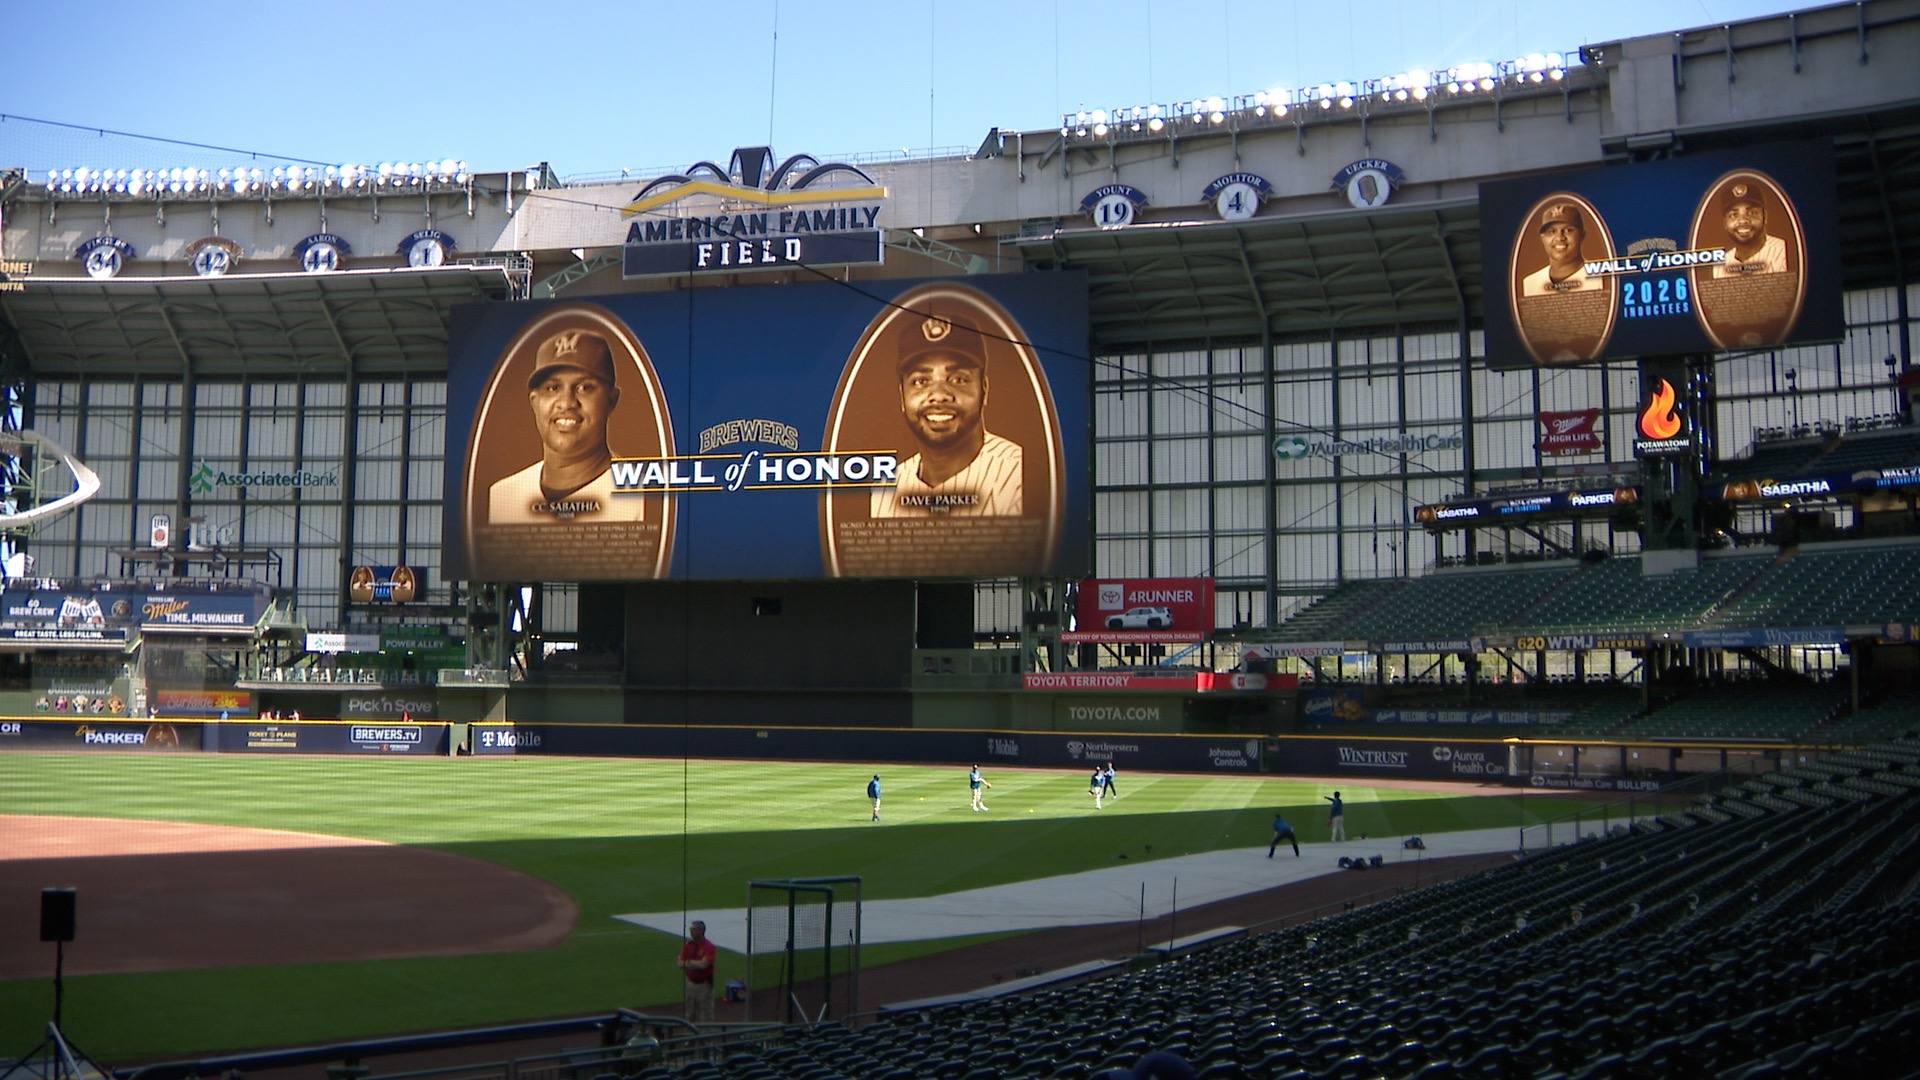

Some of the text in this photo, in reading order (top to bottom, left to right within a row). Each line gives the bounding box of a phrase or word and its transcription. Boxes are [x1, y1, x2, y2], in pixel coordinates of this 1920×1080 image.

[1345, 160, 1389, 175] UECKER
[1212, 173, 1262, 189] MOLITOR
[1095, 186, 1133, 197] YOUNT
[1228, 191, 1243, 213] 4
[1100, 202, 1127, 224] 19
[626, 206, 881, 243] AMERICAN FAMILY
[307, 234, 338, 244] AARON
[413, 230, 442, 241] SELIG
[423, 248, 430, 264] 1
[697, 238, 801, 267] FIELD
[87, 251, 117, 270] 34
[199, 251, 226, 270] 42
[307, 250, 332, 268] 44
[1584, 250, 1725, 275] WALL of HONOR
[1624, 278, 1688, 305] 2026
[1624, 302, 1690, 318] INDUCTEES
[1552, 416, 1586, 432] Miller
[700, 419, 799, 453] BREWERS
[1549, 433, 1590, 443] HIGH LIFE
[1637, 439, 1690, 449] POTAWATOMI
[611, 451, 897, 491] WALL of HONOR
[1882, 468, 1909, 478] WALL
[215, 471, 337, 487] Associated Bank
[1762, 481, 1830, 497] SABATHIA
[901, 495, 979, 506] DAVE PARKER
[1572, 494, 1614, 506] PARKER
[531, 501, 601, 513] CC SABATHIA
[1437, 507, 1479, 519] SABATHIA
[187, 523, 234, 552] Lite
[1128, 590, 1194, 602] 4RUNNER
[28, 599, 40, 608] GO
[9, 607, 55, 616] BREW CREW
[142, 600, 190, 621] Miller
[165, 613, 244, 624] TIME, MILWAUKEE
[14, 630, 36, 638] GREAT
[59, 630, 76, 638] LESS
[1061, 633, 1090, 641] COURTESY
[1765, 629, 1834, 643] WINTRUST
[385, 639, 444, 648] POWER ALLEY
[1383, 643, 1404, 651] GREAT
[1517, 635, 1593, 650] 620 WTMJ
[1597, 640, 1646, 648] BREWERS
[1026, 675, 1130, 687] TOYOTA TERRITORY
[349, 699, 379, 712] Pick
[395, 699, 432, 713] Save
[1070, 707, 1159, 721] TOYOTA.COM
[1400, 711, 1428, 723] WELCOME
[85, 733, 144, 744] PARKER
[355, 729, 417, 741] BREWERS.TV
[497, 731, 541, 747] Mobile
[995, 739, 1019, 756] Mobile
[1085, 742, 1139, 752] Northwestern
[1208, 748, 1241, 758] Johnson
[1085, 751, 1113, 760] Mutual
[1338, 747, 1408, 764] WINTRUST
[1453, 751, 1484, 762] Aurora
[1214, 757, 1247, 767] Controls
[1453, 762, 1484, 773] Health
[1617, 780, 1660, 790] BULLPEN
